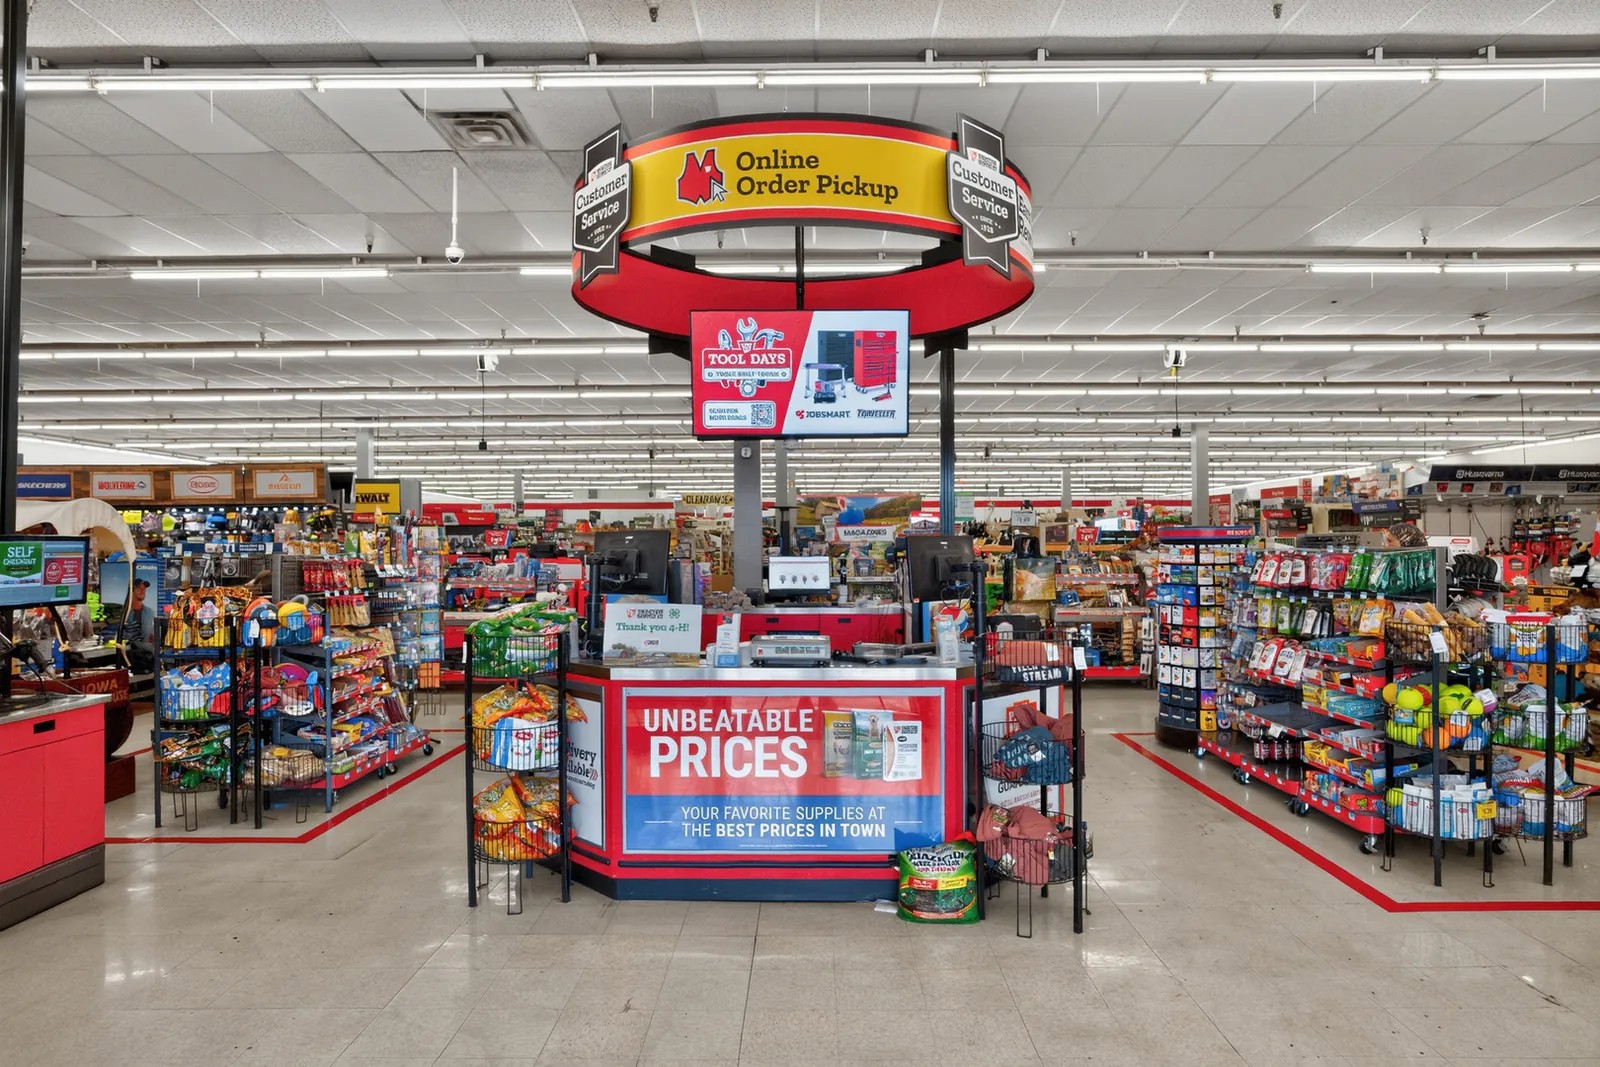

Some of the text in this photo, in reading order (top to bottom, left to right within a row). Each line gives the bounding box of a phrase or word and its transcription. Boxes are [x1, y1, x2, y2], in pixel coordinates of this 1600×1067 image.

[736, 150, 819, 172] Online
[952, 160, 1015, 200] Customer
[576, 172, 628, 210] Customer
[736, 175, 899, 206] Order Pickup
[962, 187, 1009, 220] Service
[581, 201, 620, 231] Service
[708, 353, 786, 365] TOOL DAYS
[806, 410, 851, 419] JOBSMART
[1464, 470, 1504, 478] Husqvarna
[686, 495, 728, 504] CLEARANCE
[7, 546, 35, 557] SELF
[616, 622, 689, 633] Thank you 4-H!
[1022, 669, 1062, 682] STREAM
[644, 709, 814, 733] UNBEATABLE
[650, 736, 808, 779] PRICES
[681, 806, 886, 820] YOUR FAVORITE SUPPLIES AT
[682, 823, 886, 837] THE BEST PRICES IN TOWN
